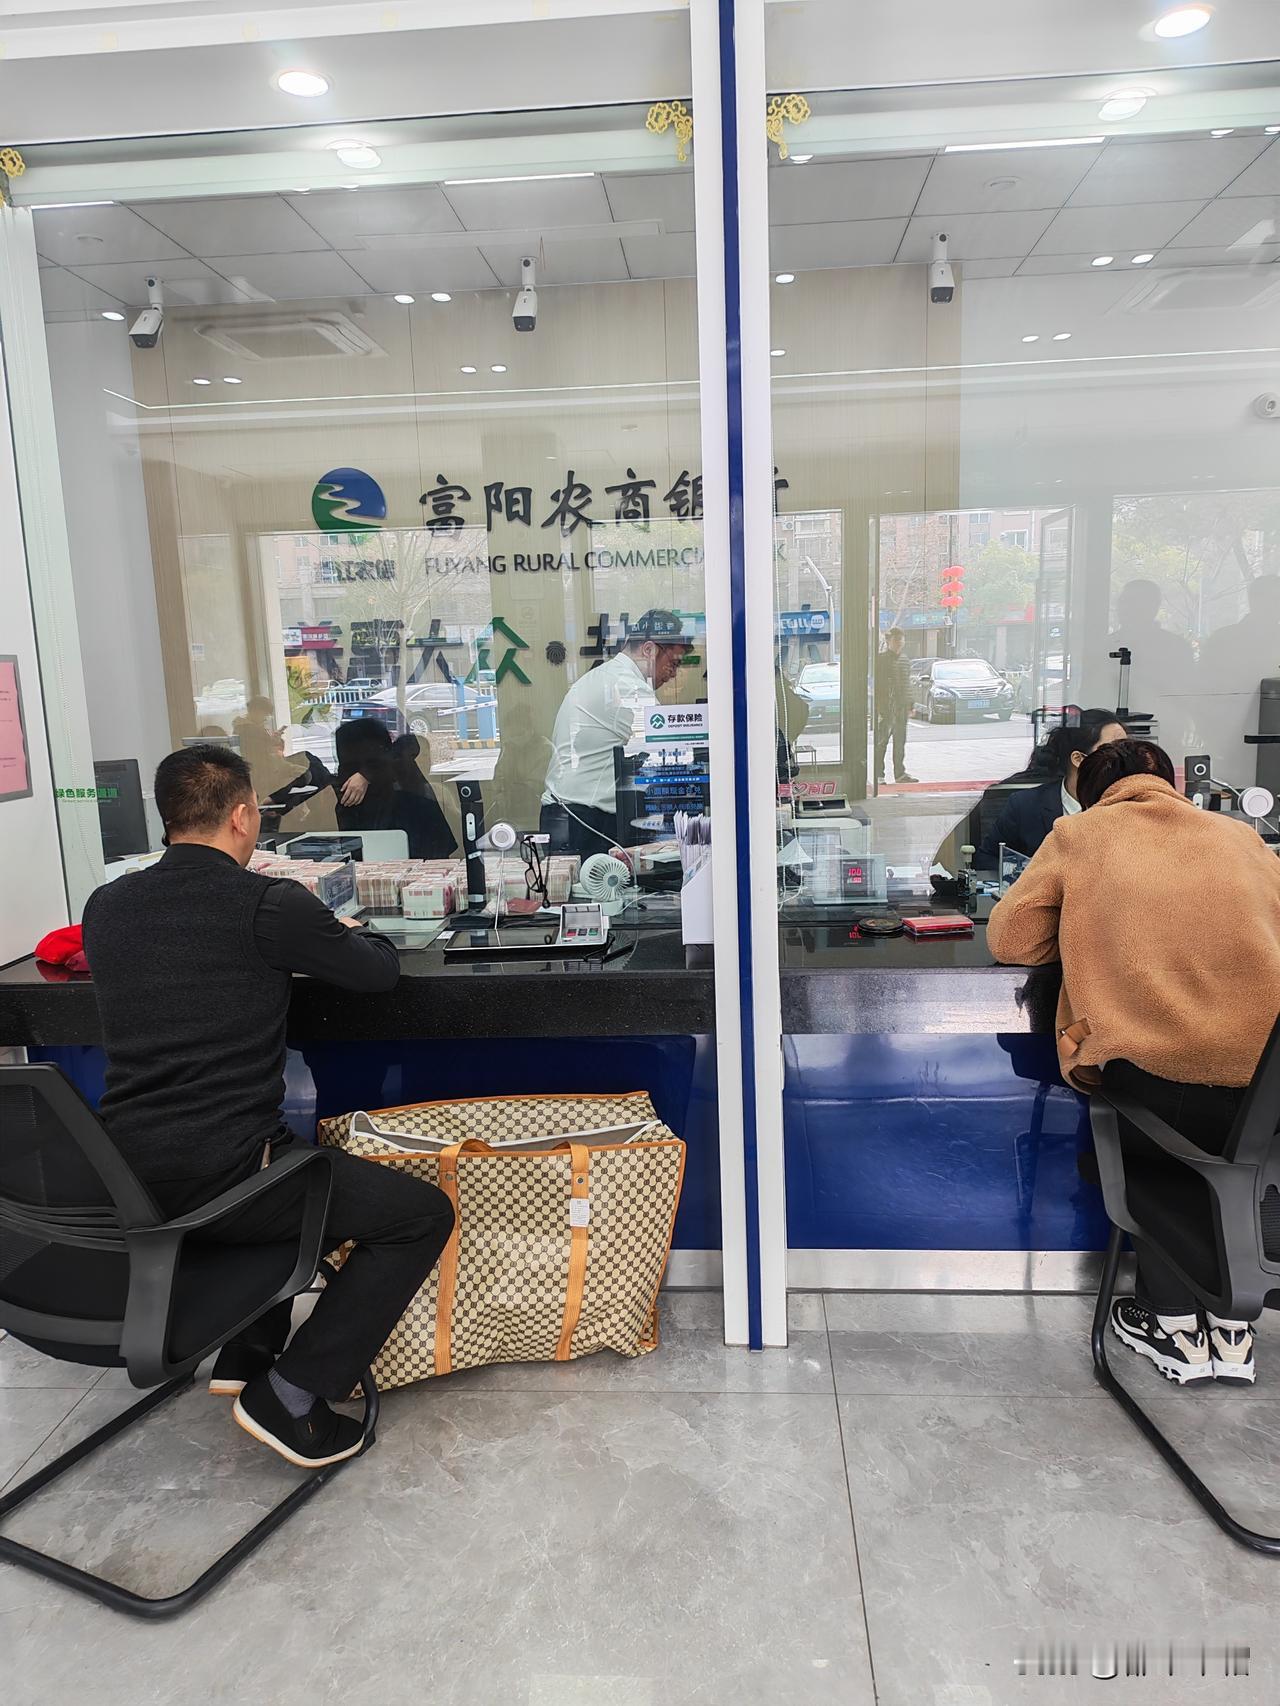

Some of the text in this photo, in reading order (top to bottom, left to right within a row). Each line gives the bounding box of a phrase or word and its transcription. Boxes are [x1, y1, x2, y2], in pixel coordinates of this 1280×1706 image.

[419, 467, 789, 540] 富阳农商银
[424, 547, 704, 574] FUYANG RURAL COMMERCI
[667, 713, 703, 723] 存款保险
